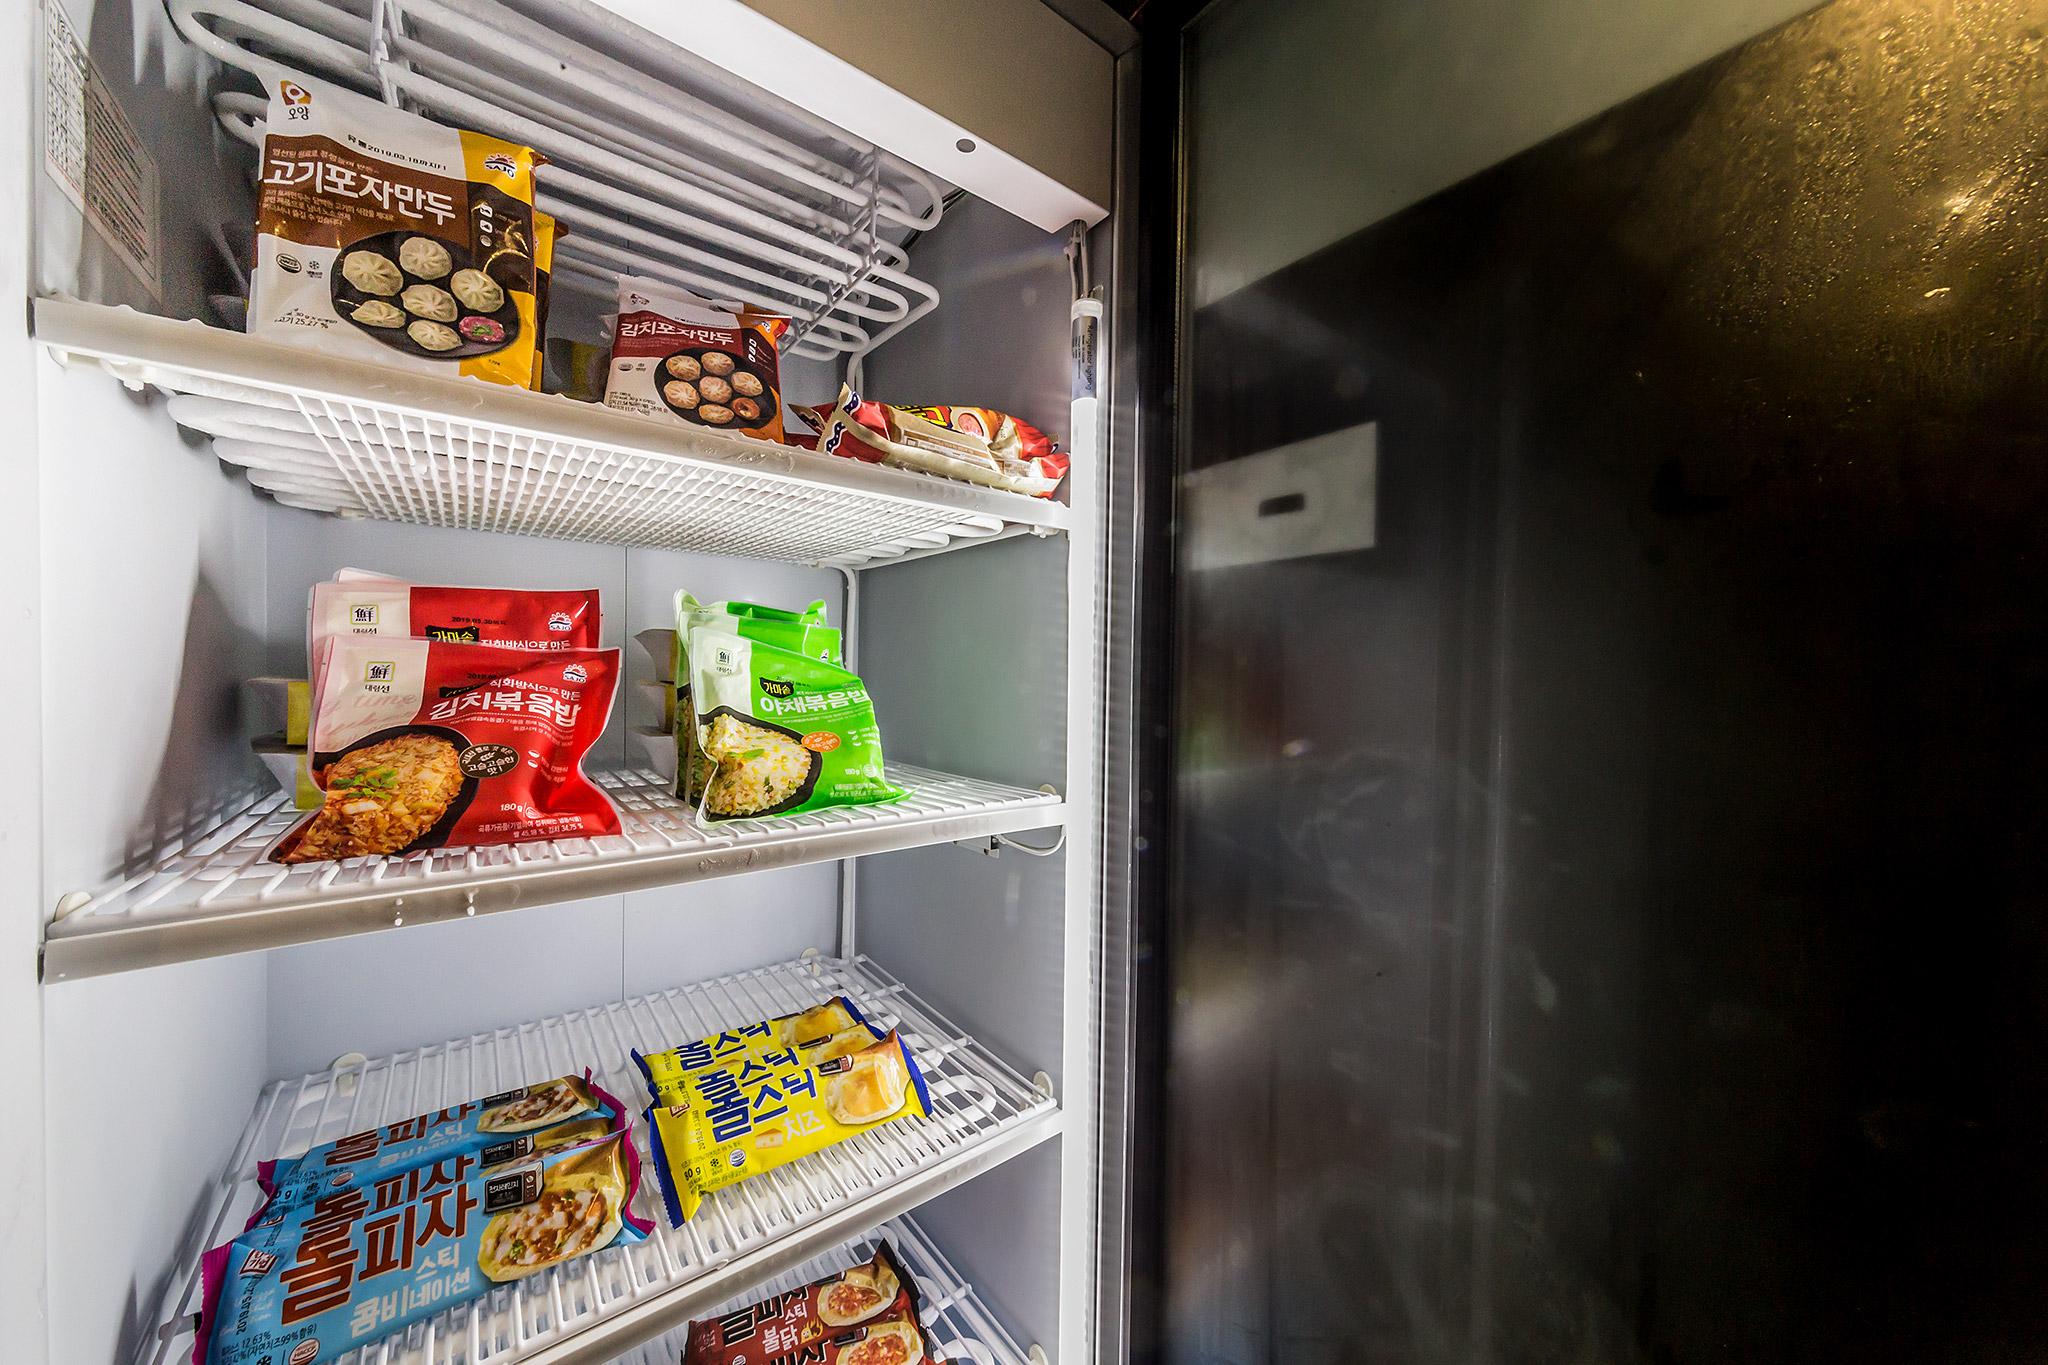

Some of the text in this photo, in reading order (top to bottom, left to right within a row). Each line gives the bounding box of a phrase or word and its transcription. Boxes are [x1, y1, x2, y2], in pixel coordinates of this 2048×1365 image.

[288, 106, 309, 120] 오양
[484, 163, 517, 179] SAJO
[263, 159, 457, 227] 고기포자만두
[620, 321, 734, 346] 김치포자만두
[564, 674, 587, 683] SAJO
[429, 691, 582, 728] 김치볶음밥
[560, 689, 582, 701] 만든
[760, 689, 870, 717] 야채볶음밥
[782, 1110, 827, 1142] 치즈
[279, 1183, 478, 1327] 롤피자
[351, 1267, 471, 1340] 콤비네이션
[762, 1324, 799, 1355] 불닭
